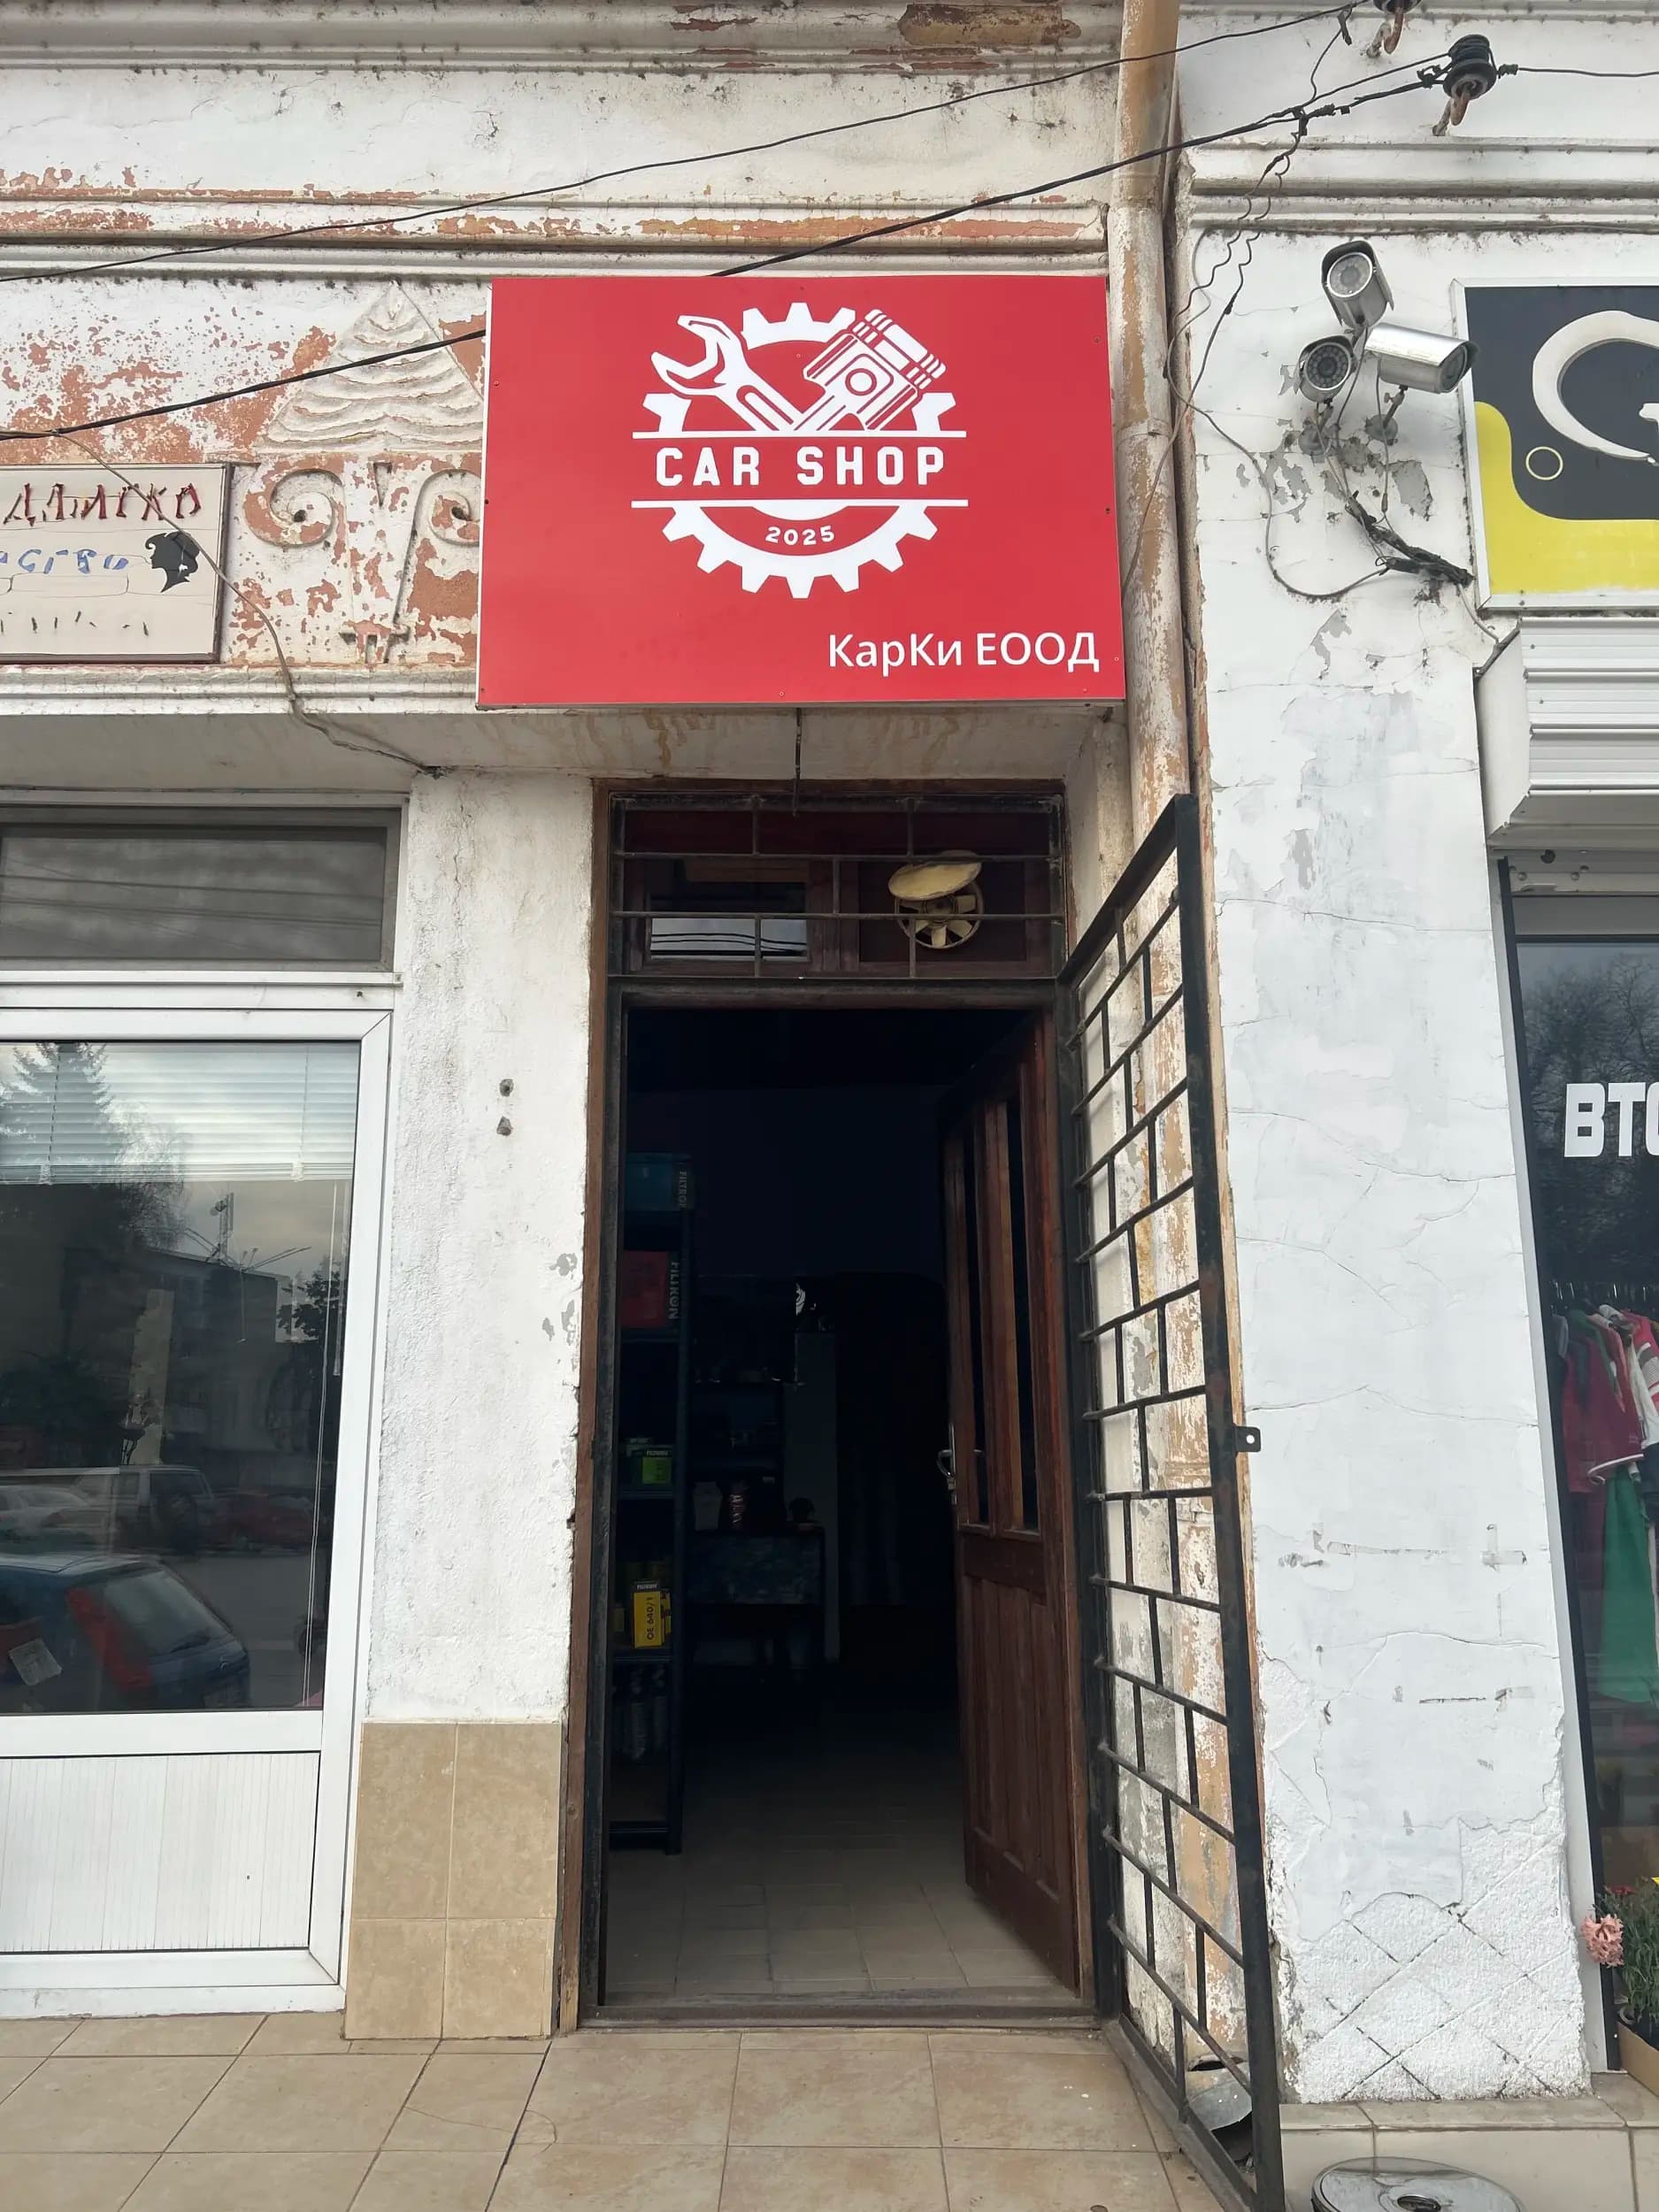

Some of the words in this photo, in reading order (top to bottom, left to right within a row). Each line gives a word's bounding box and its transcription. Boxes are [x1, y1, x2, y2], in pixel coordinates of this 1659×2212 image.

[656, 446, 760, 487] CAR
[796, 446, 944, 486] SHOP
[764, 525, 835, 546] 2025
[829, 633, 962, 678] КарКи
[976, 632, 1100, 673] ЕООД
